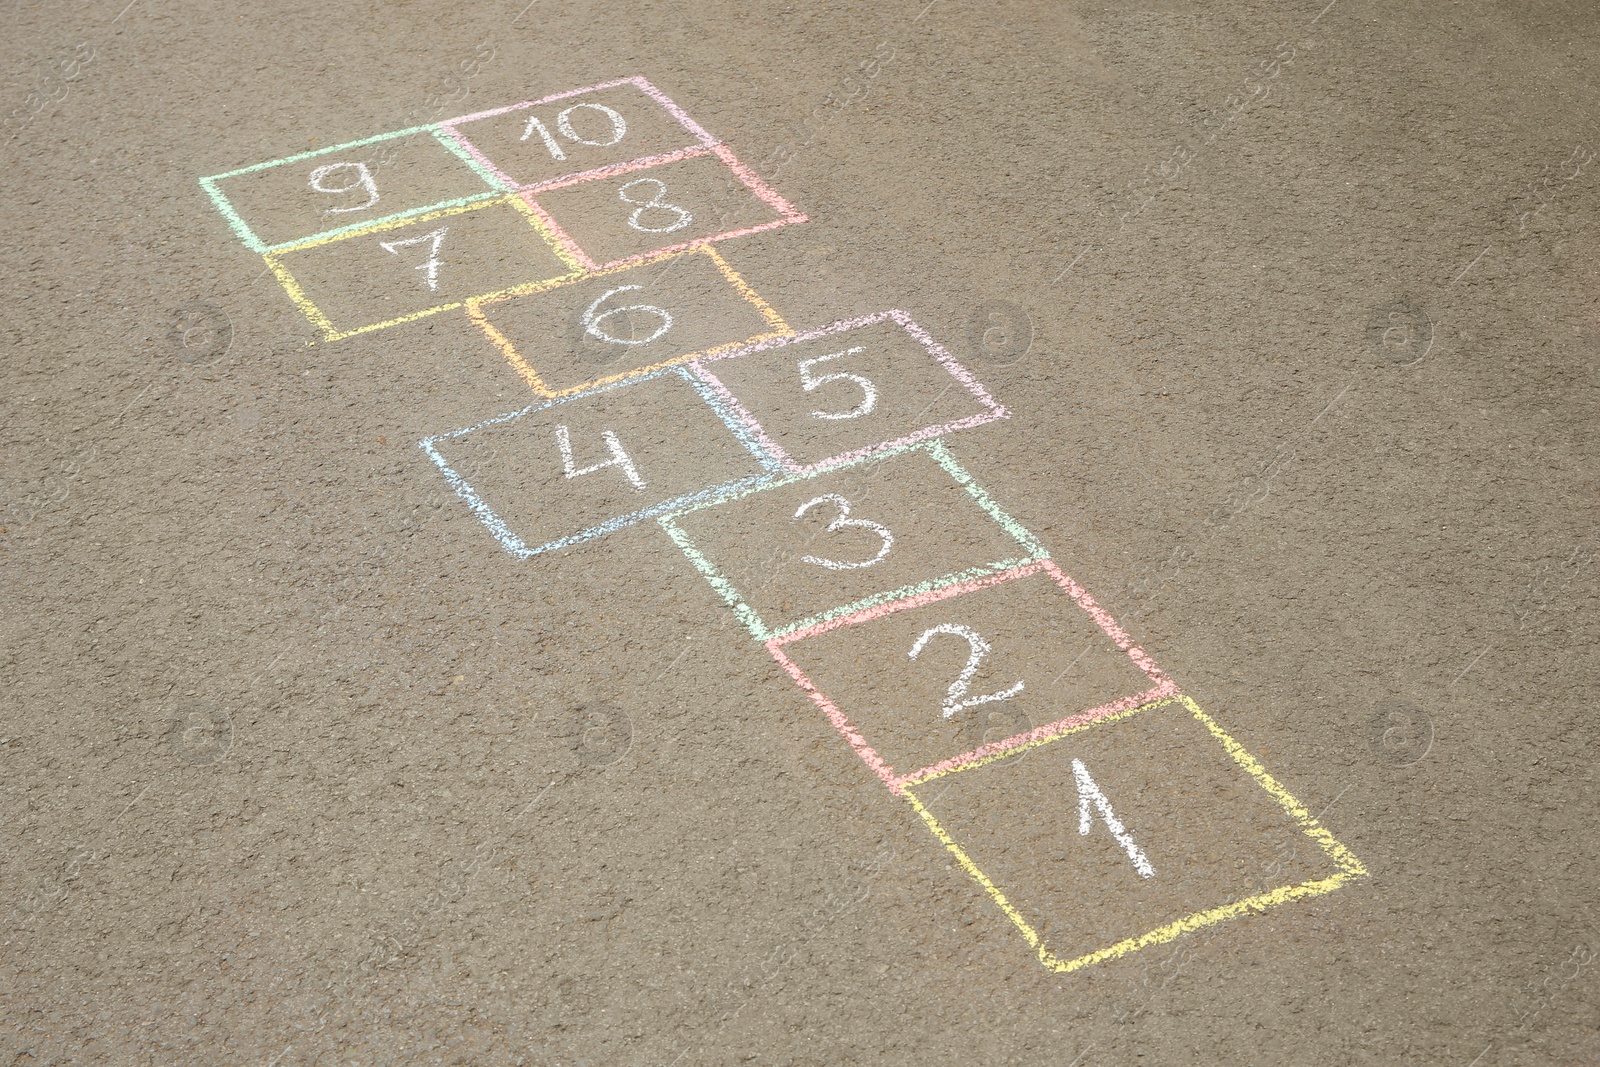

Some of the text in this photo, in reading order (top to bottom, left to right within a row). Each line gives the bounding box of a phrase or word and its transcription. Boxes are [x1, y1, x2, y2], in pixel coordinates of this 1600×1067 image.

[517, 102, 626, 162] 10
[307, 161, 381, 214] 9
[617, 176, 694, 237] 8
[379, 227, 449, 292] 7
[581, 284, 676, 348] 6
[797, 346, 879, 422] 5
[554, 424, 648, 491] 4
[794, 493, 894, 570] 3
[908, 621, 1025, 721] 2
[1069, 757, 1155, 879] 1
